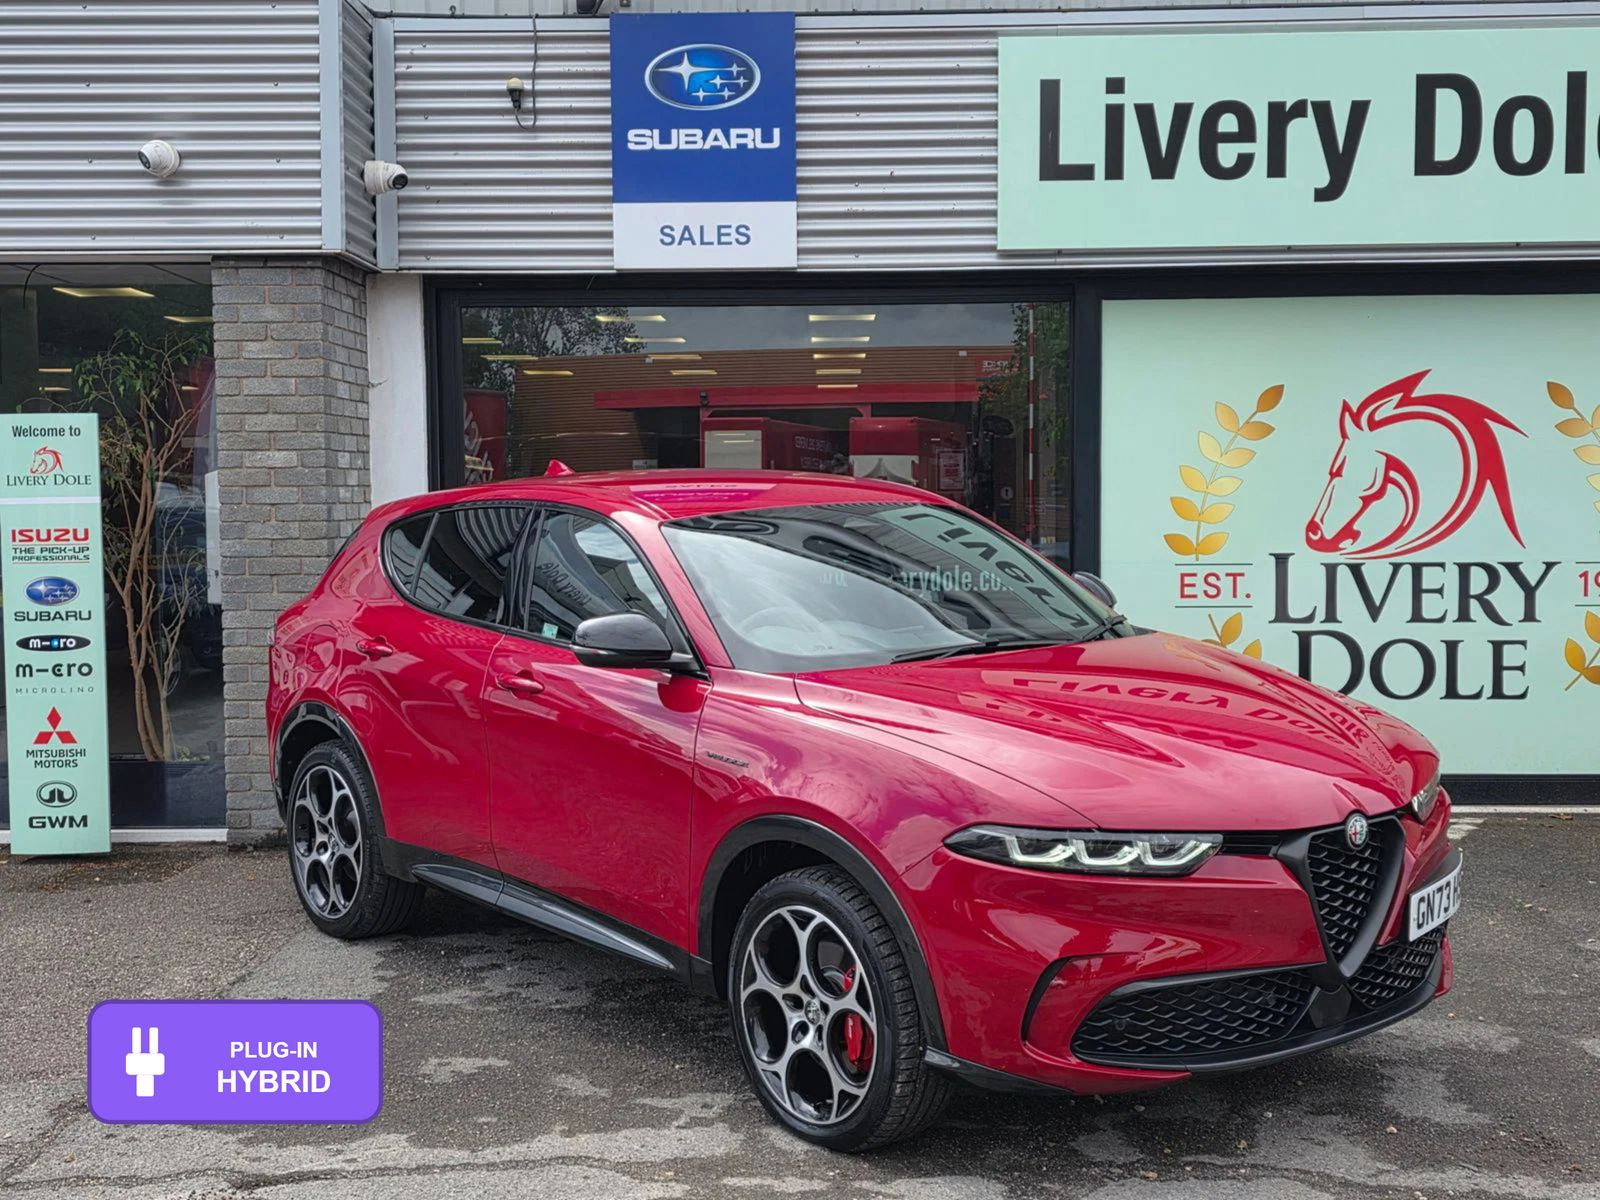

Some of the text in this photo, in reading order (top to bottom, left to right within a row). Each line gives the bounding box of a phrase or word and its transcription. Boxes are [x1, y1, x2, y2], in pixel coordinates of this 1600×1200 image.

[627, 127, 781, 151] SUBARU
[1039, 70, 1600, 203] Livery Dol
[659, 224, 752, 247] SALES
[12, 425, 81, 438] Welcome to
[6, 473, 92, 487] LIVERY DOLE
[11, 527, 89, 543] ISUZU
[12, 546, 90, 555] THE PICK-UP
[12, 554, 90, 562] PROFESSIONALS
[1179, 571, 1252, 599] EST.
[1268, 552, 1562, 627] LIVERY
[14, 610, 92, 622] SUBARU
[1291, 629, 1530, 701] DOLE
[15, 686, 94, 694] MICROLINO
[26, 748, 87, 759] MITSUBISHI
[34, 758, 79, 769] MOTORS
[28, 814, 88, 829] GWM
[1416, 880, 1452, 930] GN73
